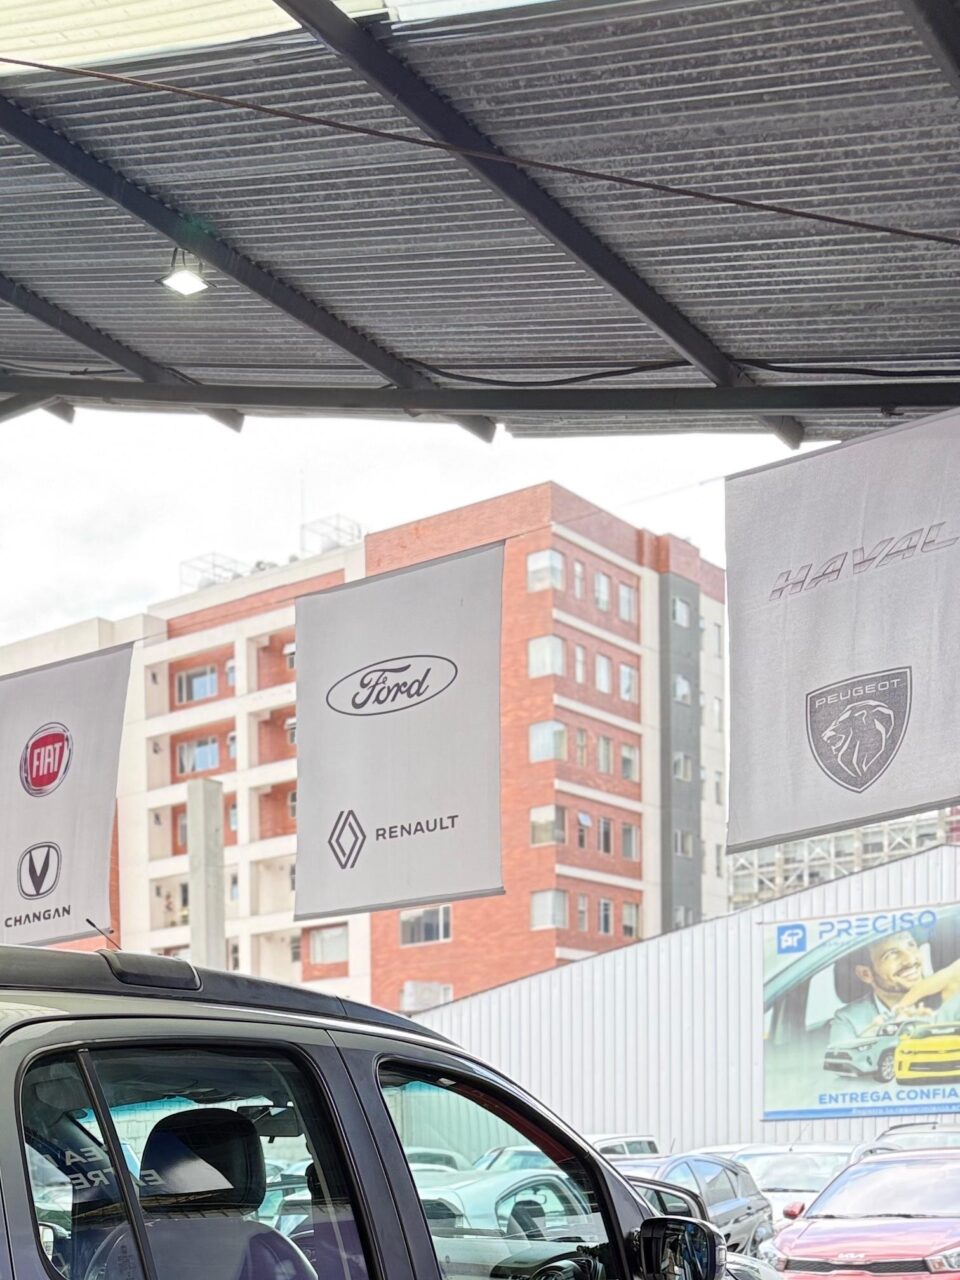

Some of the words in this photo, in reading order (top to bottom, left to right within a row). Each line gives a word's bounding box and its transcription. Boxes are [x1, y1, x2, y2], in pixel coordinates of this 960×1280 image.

[769, 521, 959, 601] HAVAL
[351, 664, 432, 709] Ford
[815, 678, 901, 708] PEUGEOT
[32, 742, 63, 778] FIAT
[375, 815, 459, 841] RENAULT
[4, 905, 71, 927] CHANGAN
[818, 910, 937, 939] PRECISO
[818, 1091, 893, 1104] ENTREGA
[895, 1088, 959, 1101] CONFIA
